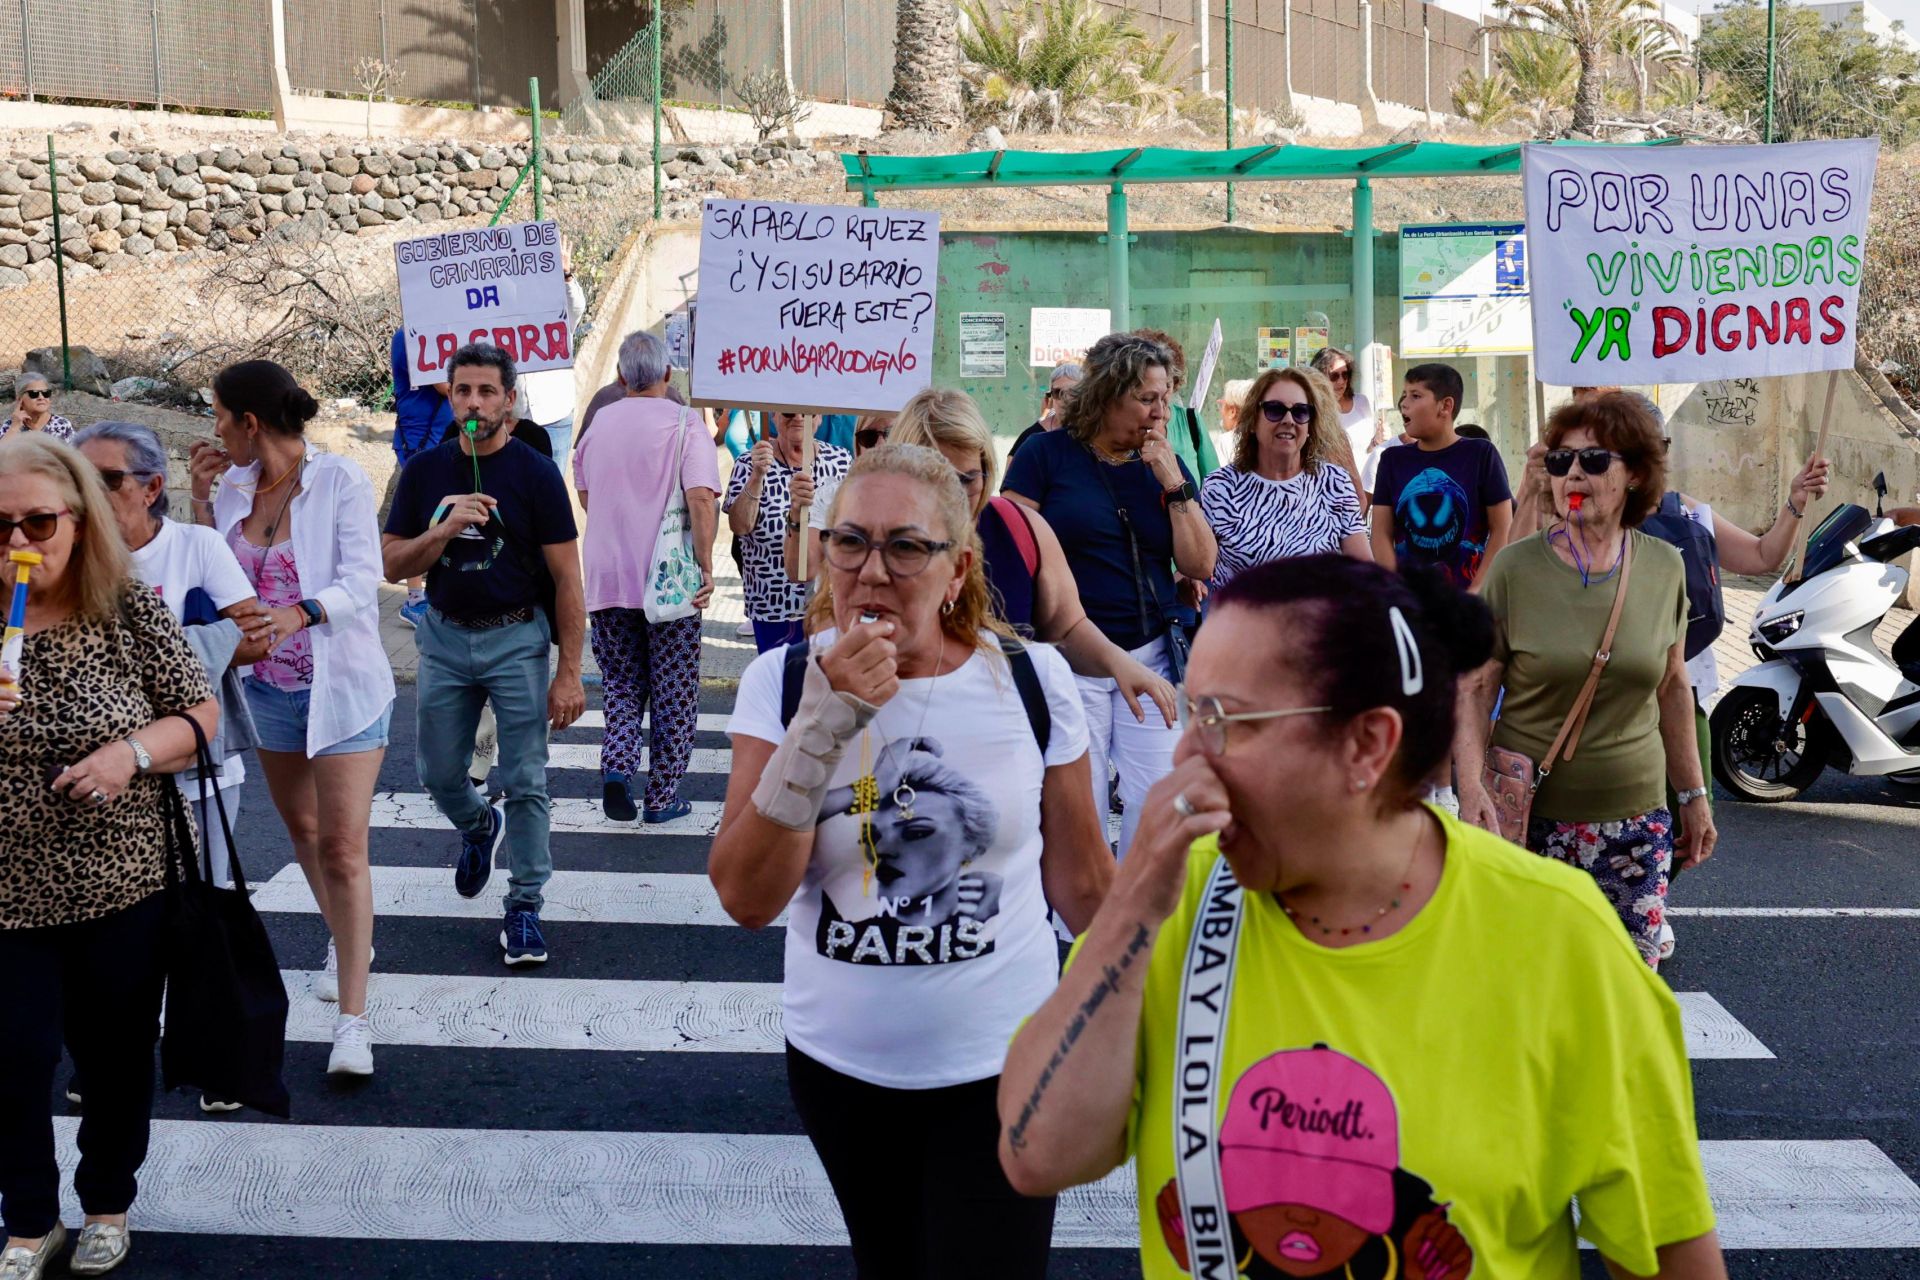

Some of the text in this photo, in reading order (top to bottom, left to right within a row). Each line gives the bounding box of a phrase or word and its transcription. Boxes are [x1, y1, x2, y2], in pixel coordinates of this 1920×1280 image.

[1547, 167, 1852, 235] POR UNAS
[524, 223, 557, 247] DE
[751, 206, 835, 243] PABLO
[846, 215, 928, 251] RGUEZ
[772, 261, 797, 290] SI
[802, 259, 833, 290] SU
[840, 257, 922, 289] BARRIO
[466, 285, 500, 310] DA
[780, 292, 933, 334] FUERA ESTE?
[718, 336, 917, 385] #PORUNBARRIODIGNO
[920, 895, 933, 917] 1
[826, 916, 987, 964] PARIS
[1181, 1035, 1214, 1161] LOLA
